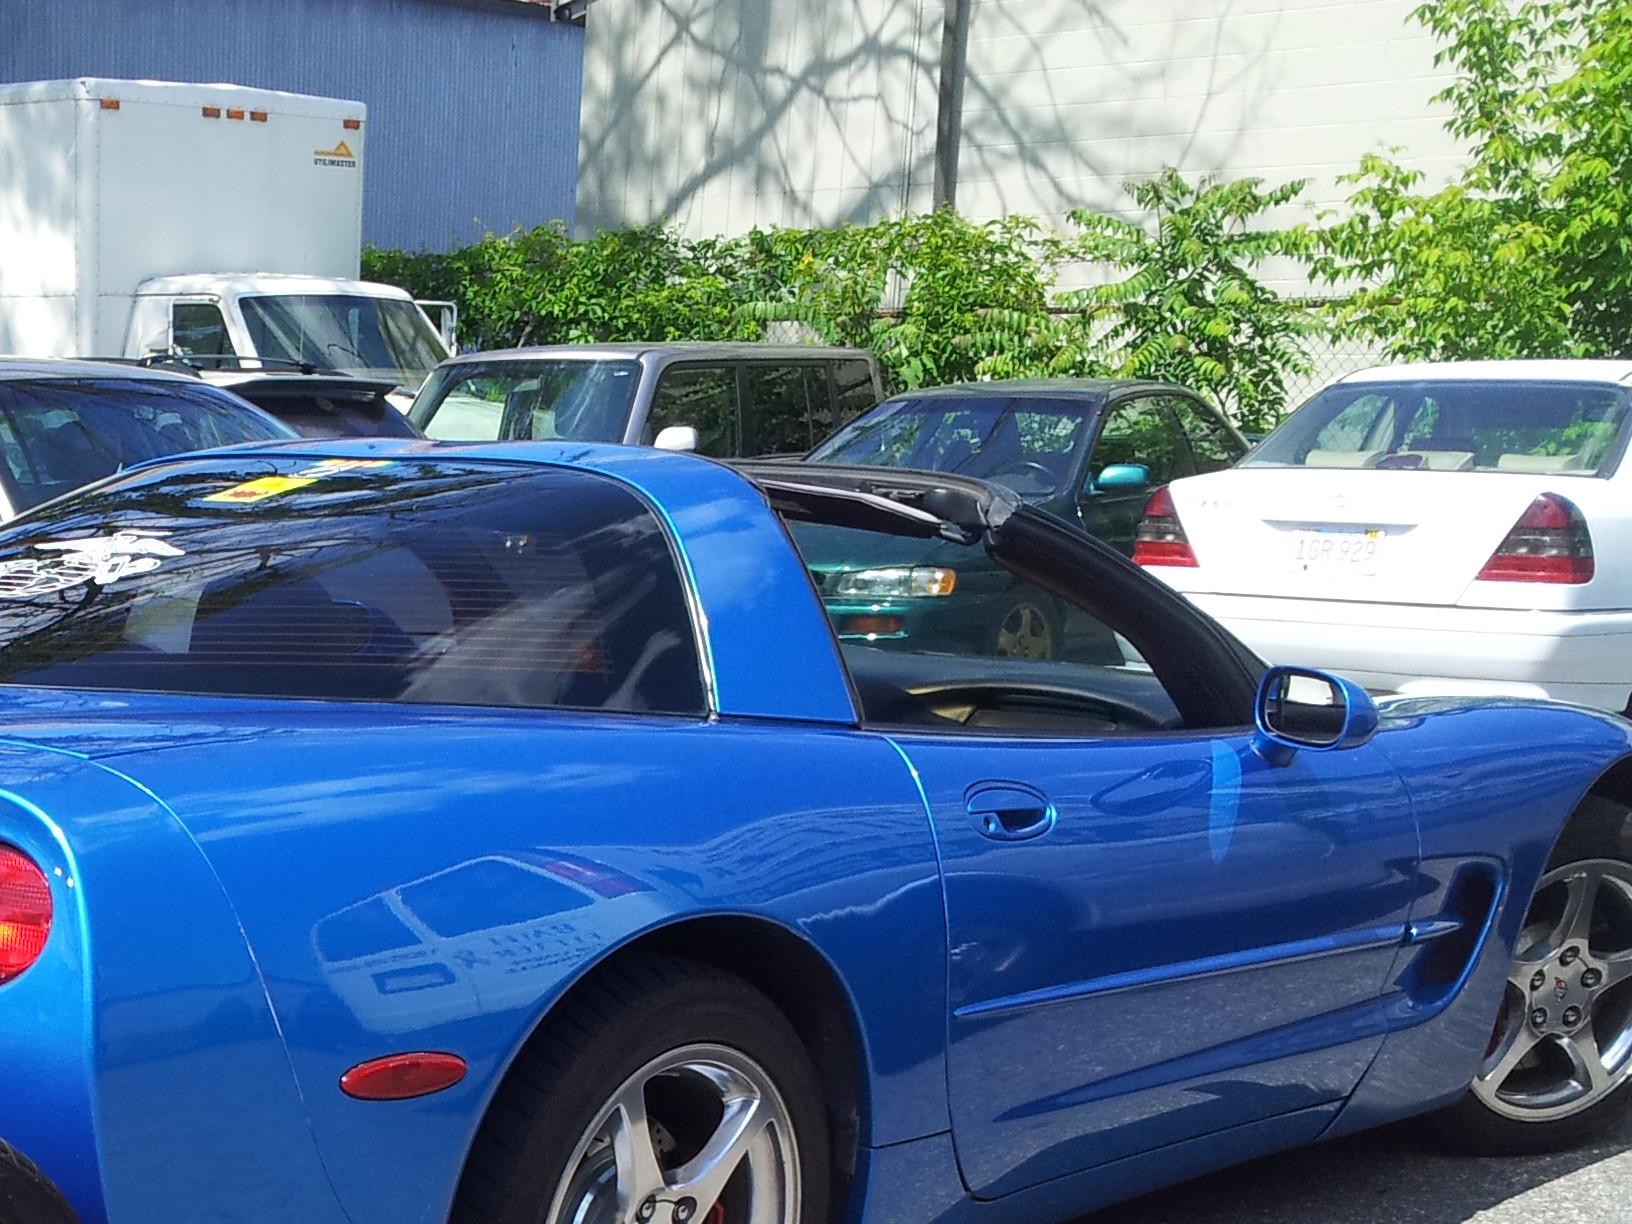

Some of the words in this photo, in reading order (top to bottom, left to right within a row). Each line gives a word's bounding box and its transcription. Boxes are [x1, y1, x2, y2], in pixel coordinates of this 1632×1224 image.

[313, 158, 356, 168] UTILIMASTER
[1296, 539, 1333, 561] 1GR
[1339, 540, 1376, 562] 929
